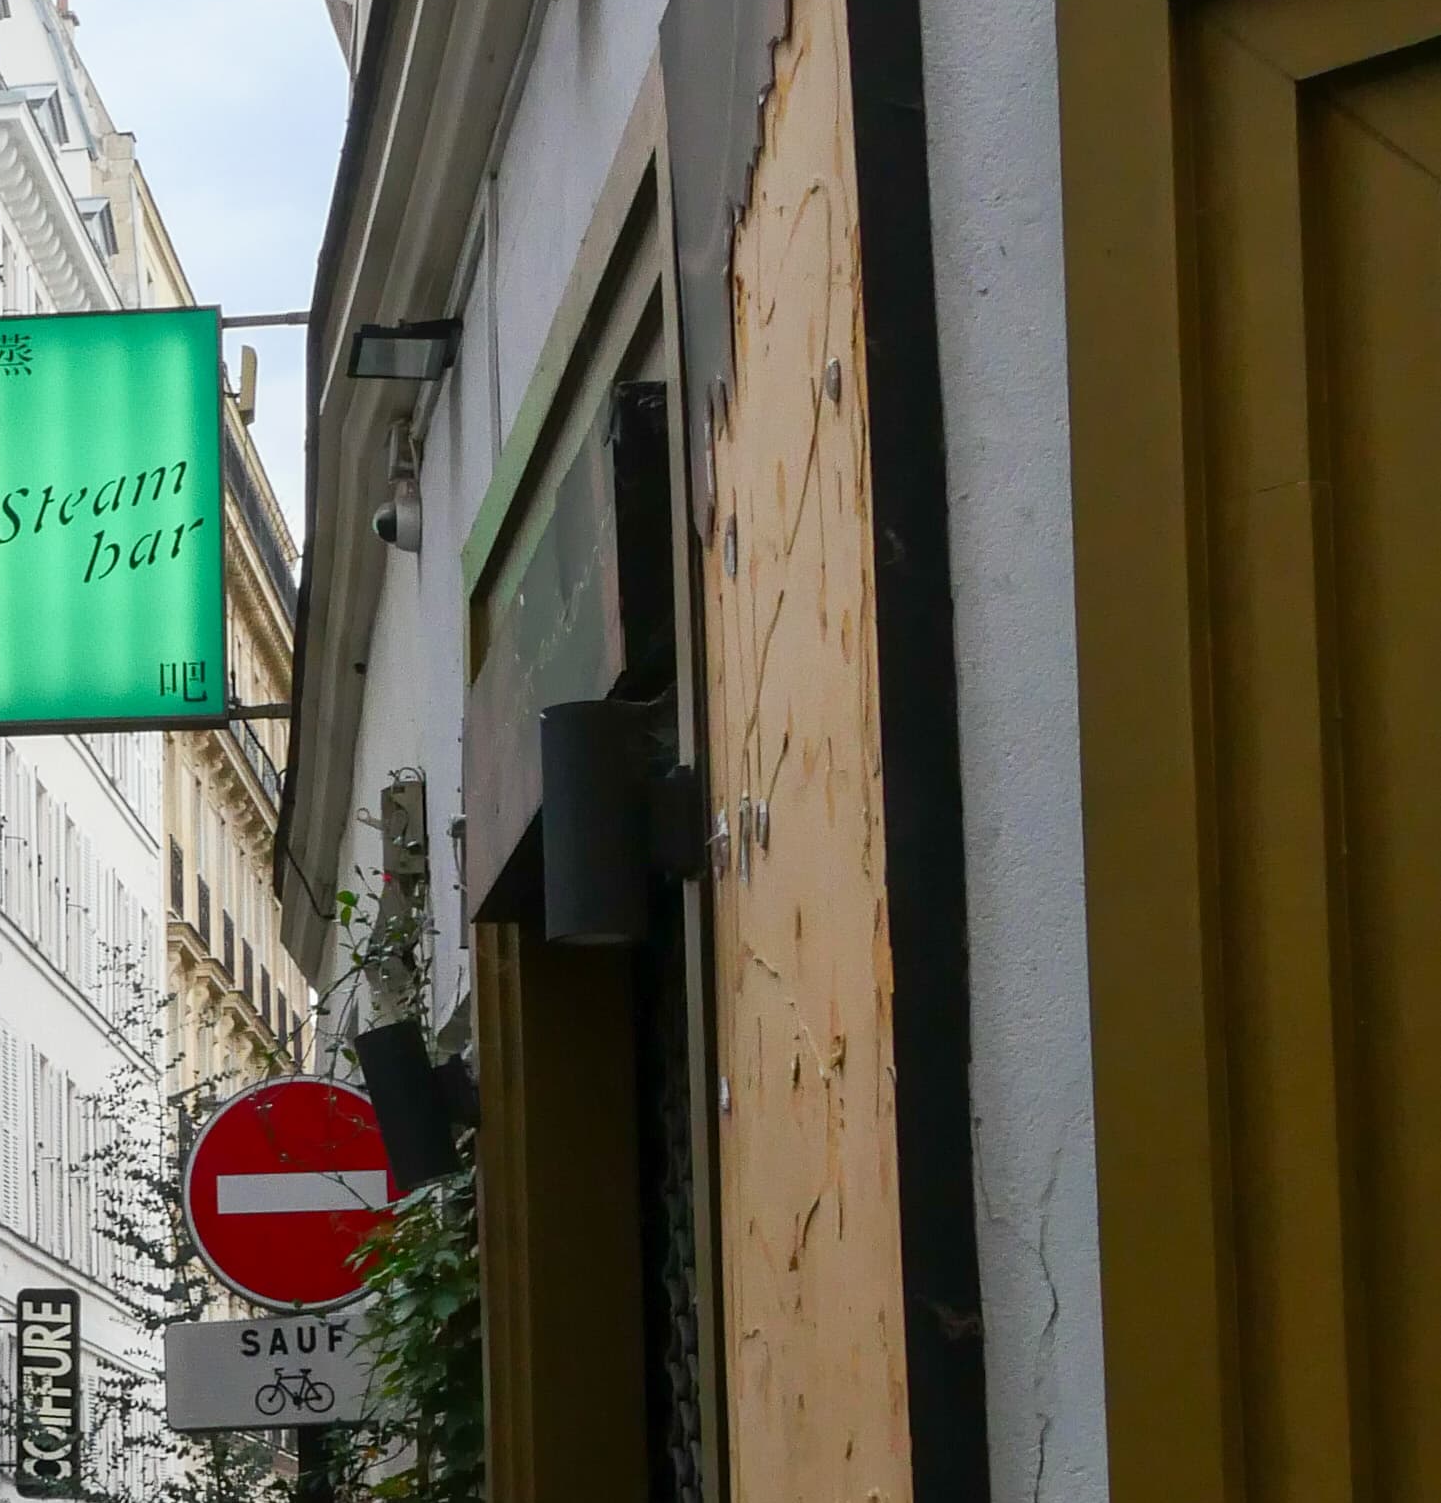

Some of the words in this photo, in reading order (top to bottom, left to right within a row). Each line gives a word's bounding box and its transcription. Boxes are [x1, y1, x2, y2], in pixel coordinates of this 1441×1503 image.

[83, 516, 205, 583] bar
[159, 660, 209, 703] 吧
[240, 1324, 349, 1358] SAUF
[21, 1299, 73, 1481] COIFFURE
